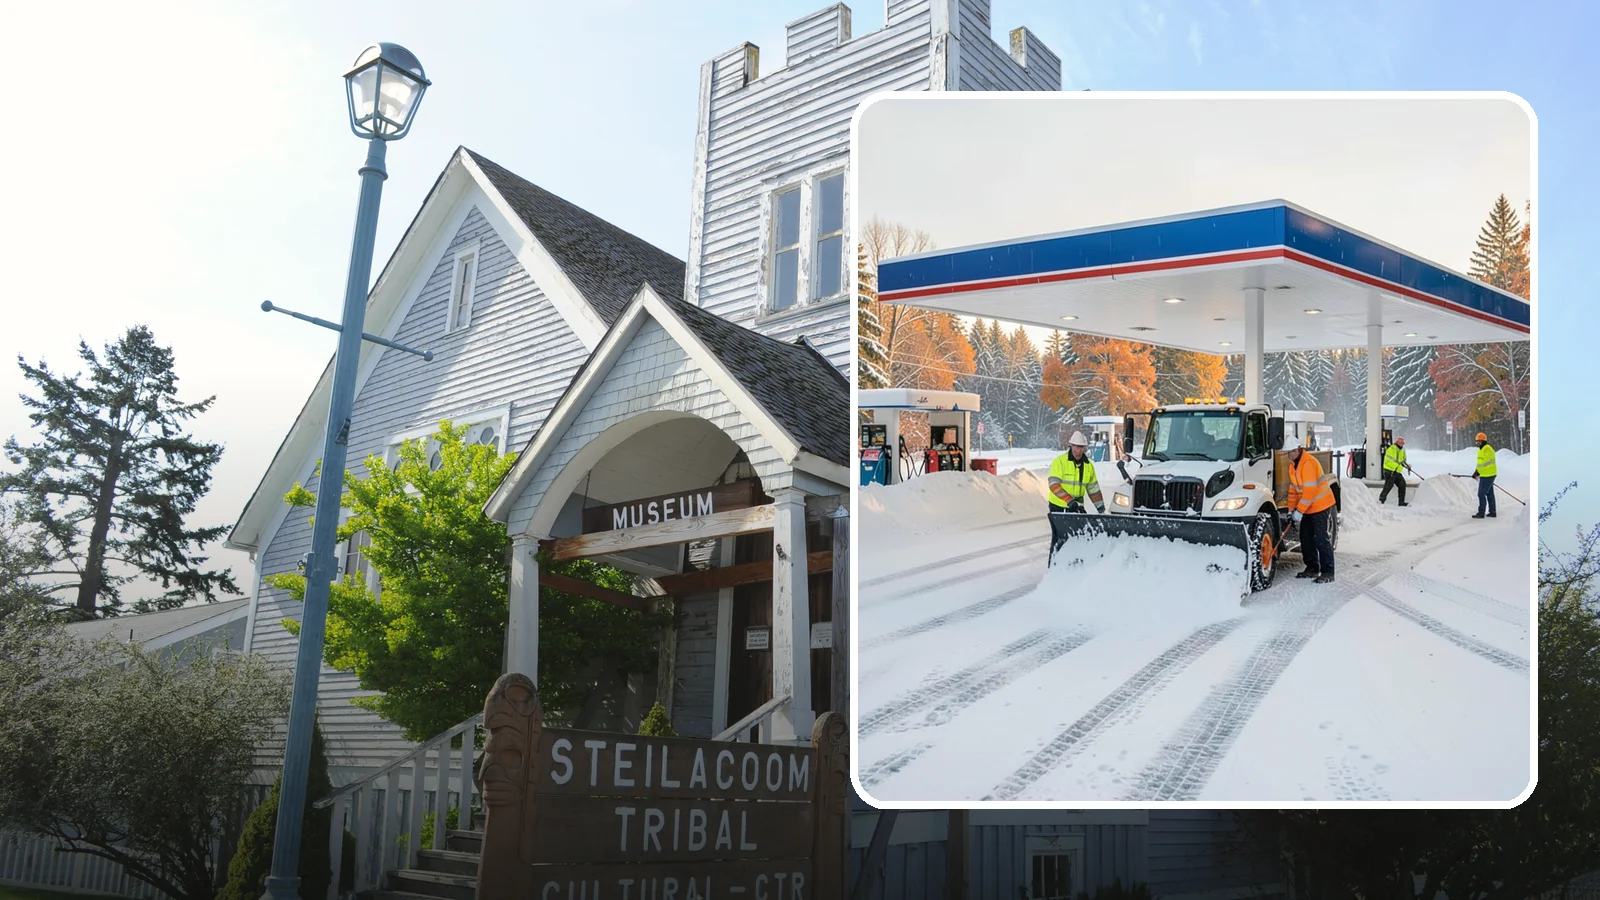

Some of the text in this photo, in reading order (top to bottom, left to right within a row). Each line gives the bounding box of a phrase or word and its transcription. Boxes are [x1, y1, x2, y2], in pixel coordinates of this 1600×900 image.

[612, 492, 713, 531] MUSEUM
[550, 738, 809, 793] STEILACOOM
[614, 806, 758, 852] TRIBAL
